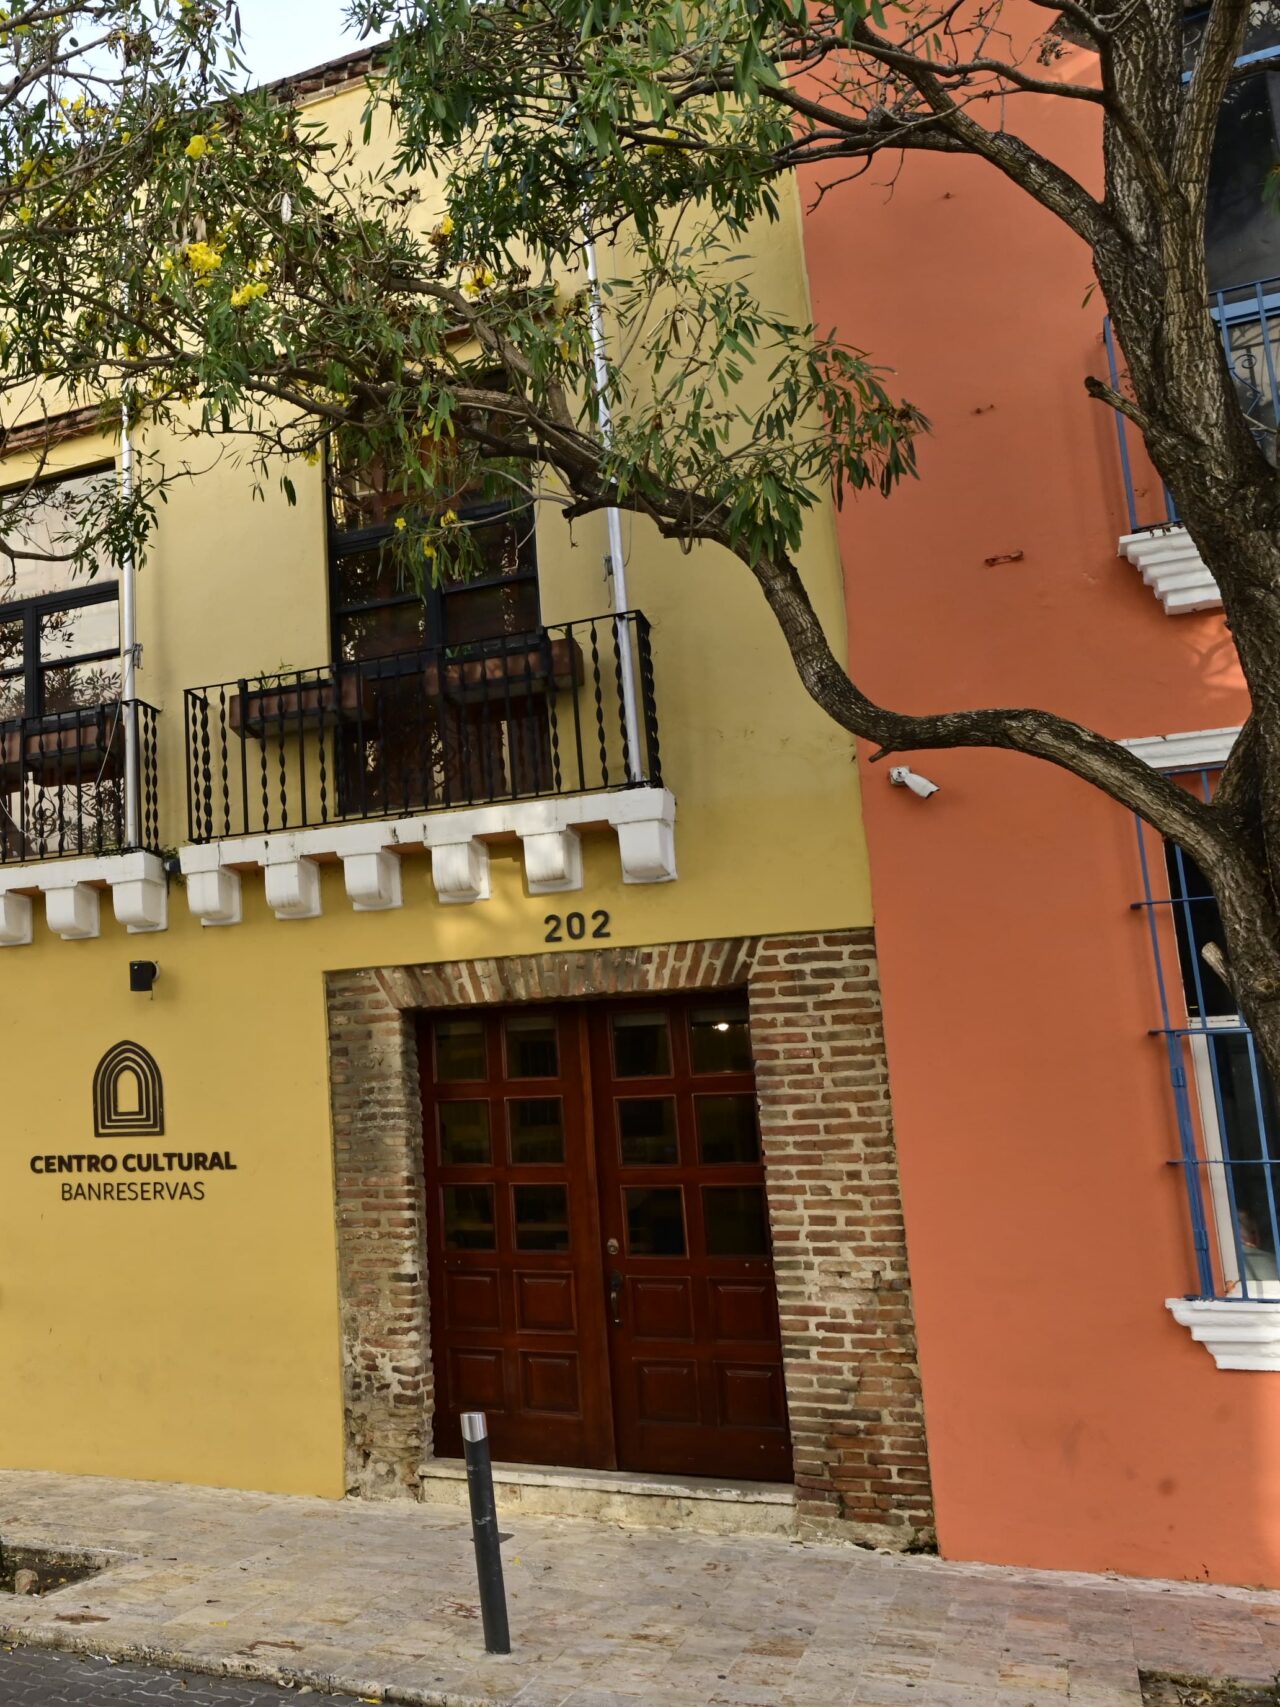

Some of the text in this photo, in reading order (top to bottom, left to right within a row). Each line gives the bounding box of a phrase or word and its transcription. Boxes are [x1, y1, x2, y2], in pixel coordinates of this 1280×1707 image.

[544, 909, 611, 943] 202
[30, 1151, 237, 1174] CENTRO CULTURAL
[61, 1181, 205, 1201] BANRESERVAS
